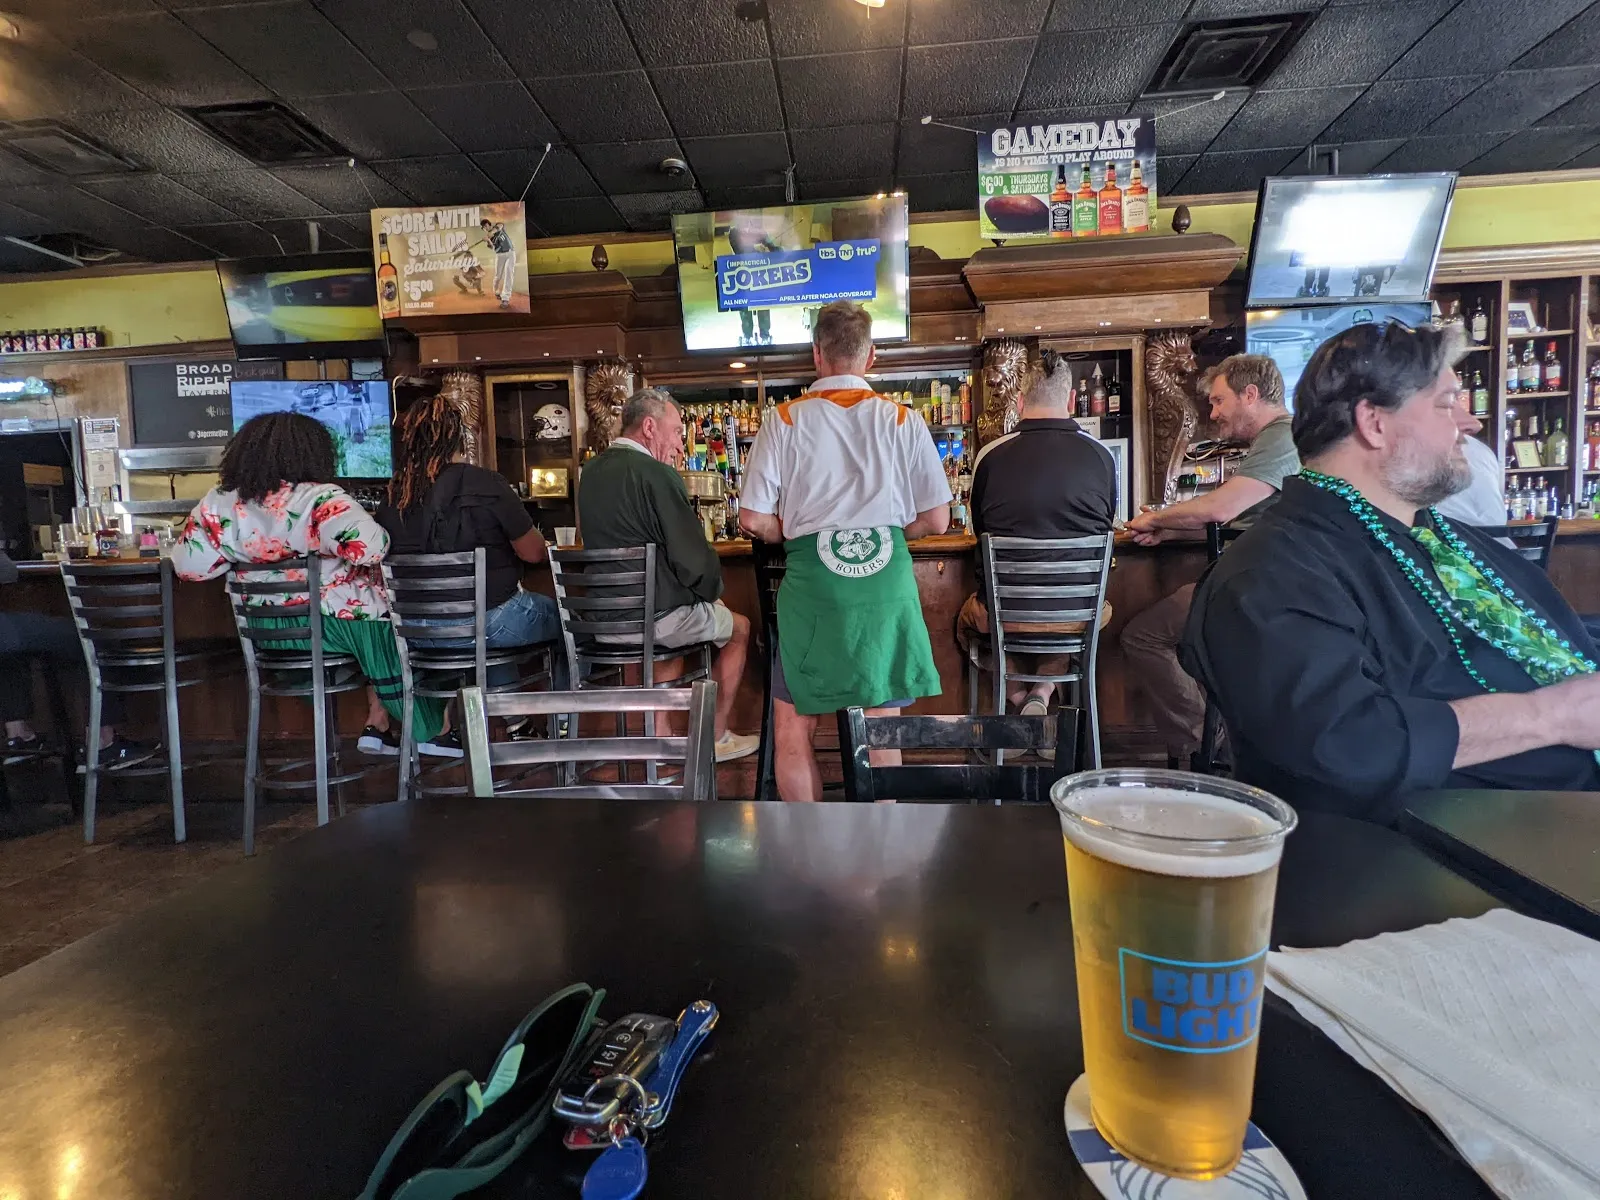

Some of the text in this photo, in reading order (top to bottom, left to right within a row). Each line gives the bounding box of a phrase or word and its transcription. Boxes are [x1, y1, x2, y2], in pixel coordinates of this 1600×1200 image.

[992, 118, 1141, 157] GAMEDAY
[995, 150, 1135, 167] IS NO TIME TO PLAY AROUND
[1010, 173, 1048, 185] THURSDAYS
[1002, 183, 1049, 194] & SATURDAYS
[382, 206, 481, 236] SCORE WITH
[408, 232, 468, 257] SAILOR
[820, 247, 835, 258] tbs
[839, 248, 853, 258] TNT
[403, 255, 480, 277] Saturdays
[723, 261, 811, 294] JOKERS
[176, 364, 232, 375] BROAD
[177, 376, 232, 387] RIPPLE
[183, 388, 229, 396] TAVERN
[835, 559, 884, 575] BOILERS
[1153, 968, 1255, 1006] BUD
